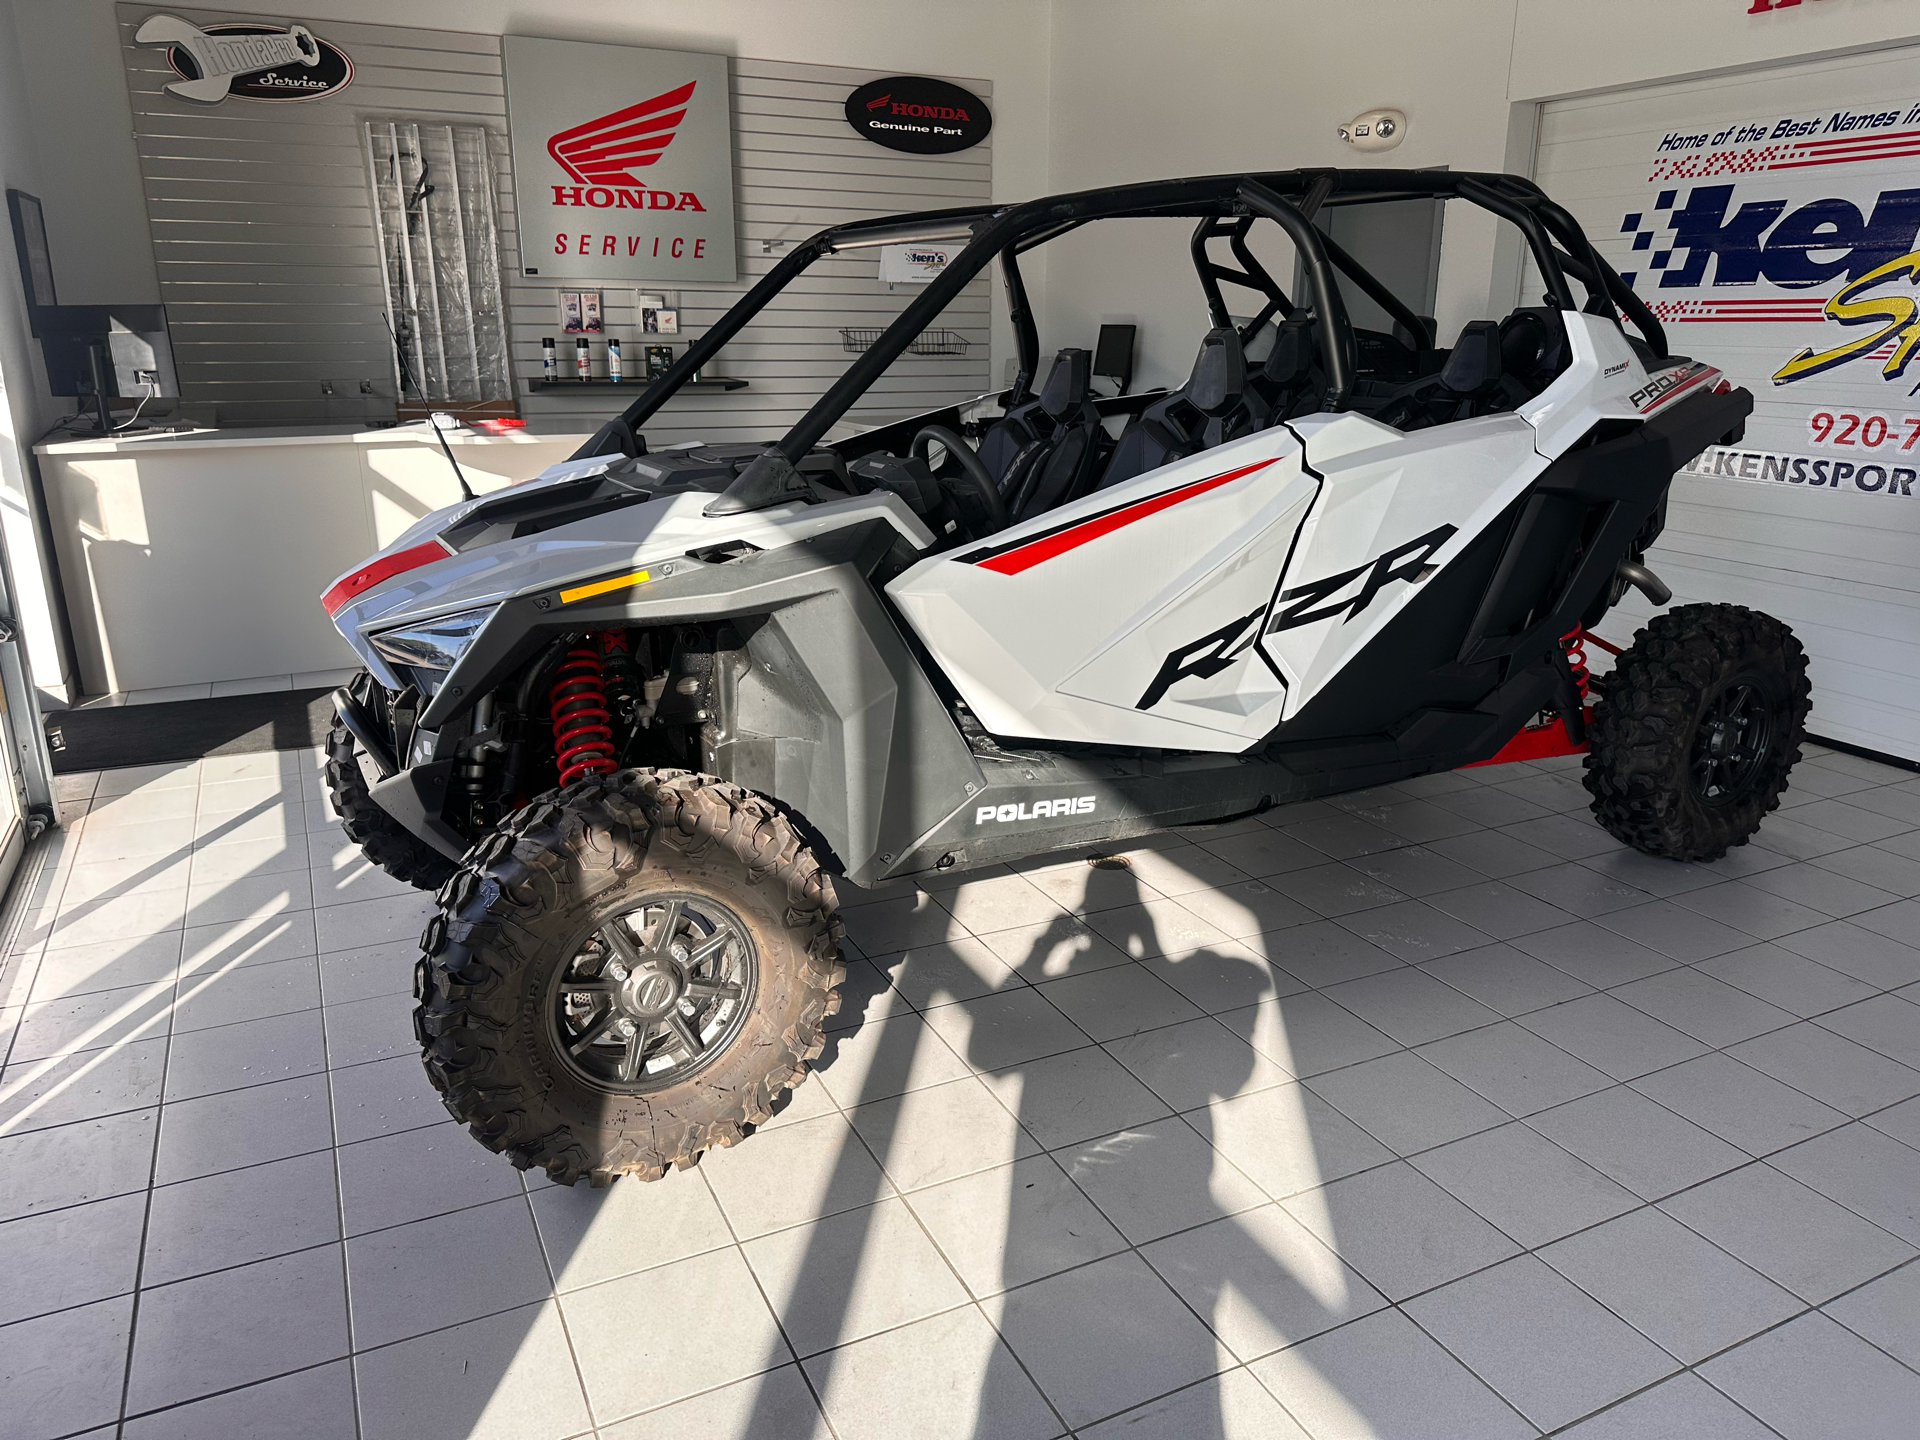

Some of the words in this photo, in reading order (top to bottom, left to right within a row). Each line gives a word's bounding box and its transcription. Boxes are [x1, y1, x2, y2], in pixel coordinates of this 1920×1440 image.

[193, 36, 298, 77] HondaPro
[259, 72, 329, 89] Service
[890, 102, 971, 121] HONDA
[869, 120, 930, 133] Genuine
[933, 126, 963, 136] Part
[1657, 133, 1709, 152] Home
[1711, 126, 1736, 146] of
[1734, 124, 1768, 142] the
[1769, 119, 1822, 140] Best
[1822, 111, 1901, 133] Names
[551, 185, 707, 212] HONDA
[554, 233, 706, 259] SERVICE
[911, 252, 945, 263] ken's
[1604, 359, 1630, 376] DYNAMIX
[1134, 523, 1459, 711] RZR
[975, 795, 1097, 825] POLARIS
